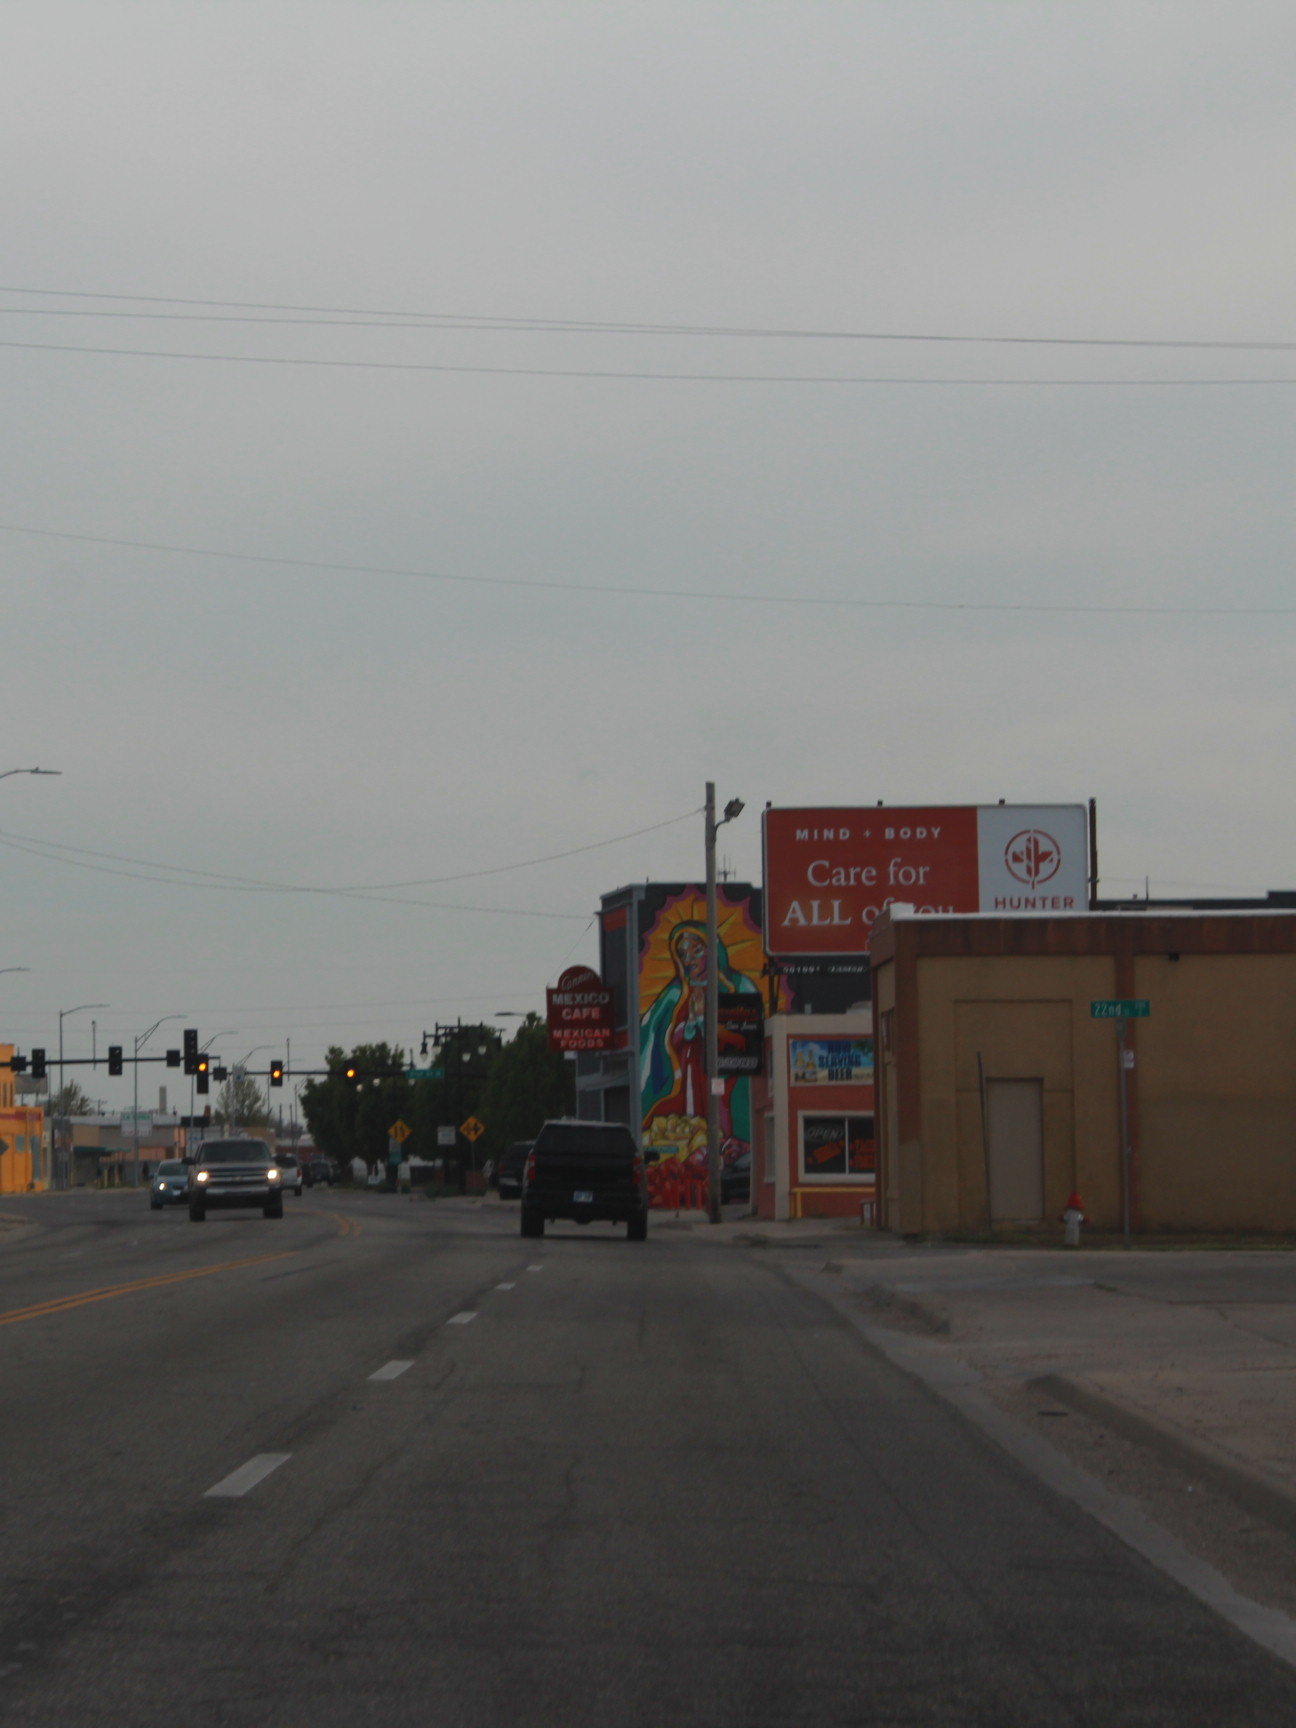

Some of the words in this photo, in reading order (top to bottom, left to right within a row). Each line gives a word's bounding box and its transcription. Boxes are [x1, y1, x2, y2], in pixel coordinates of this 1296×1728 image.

[795, 827, 850, 841] MIND
[884, 827, 942, 840] BODY
[806, 859, 878, 887] Care
[888, 857, 931, 886] for
[994, 896, 1075, 910] HUNTER
[781, 899, 852, 926] ALL
[552, 992, 610, 1006] MEXICO
[561, 1007, 601, 1020] CAFE
[1094, 1003, 1121, 1016] 22nd
[553, 1028, 610, 1039] MEXICAN
[560, 1039, 605, 1049] FOODS
[807, 1127, 838, 1139] OPEN
